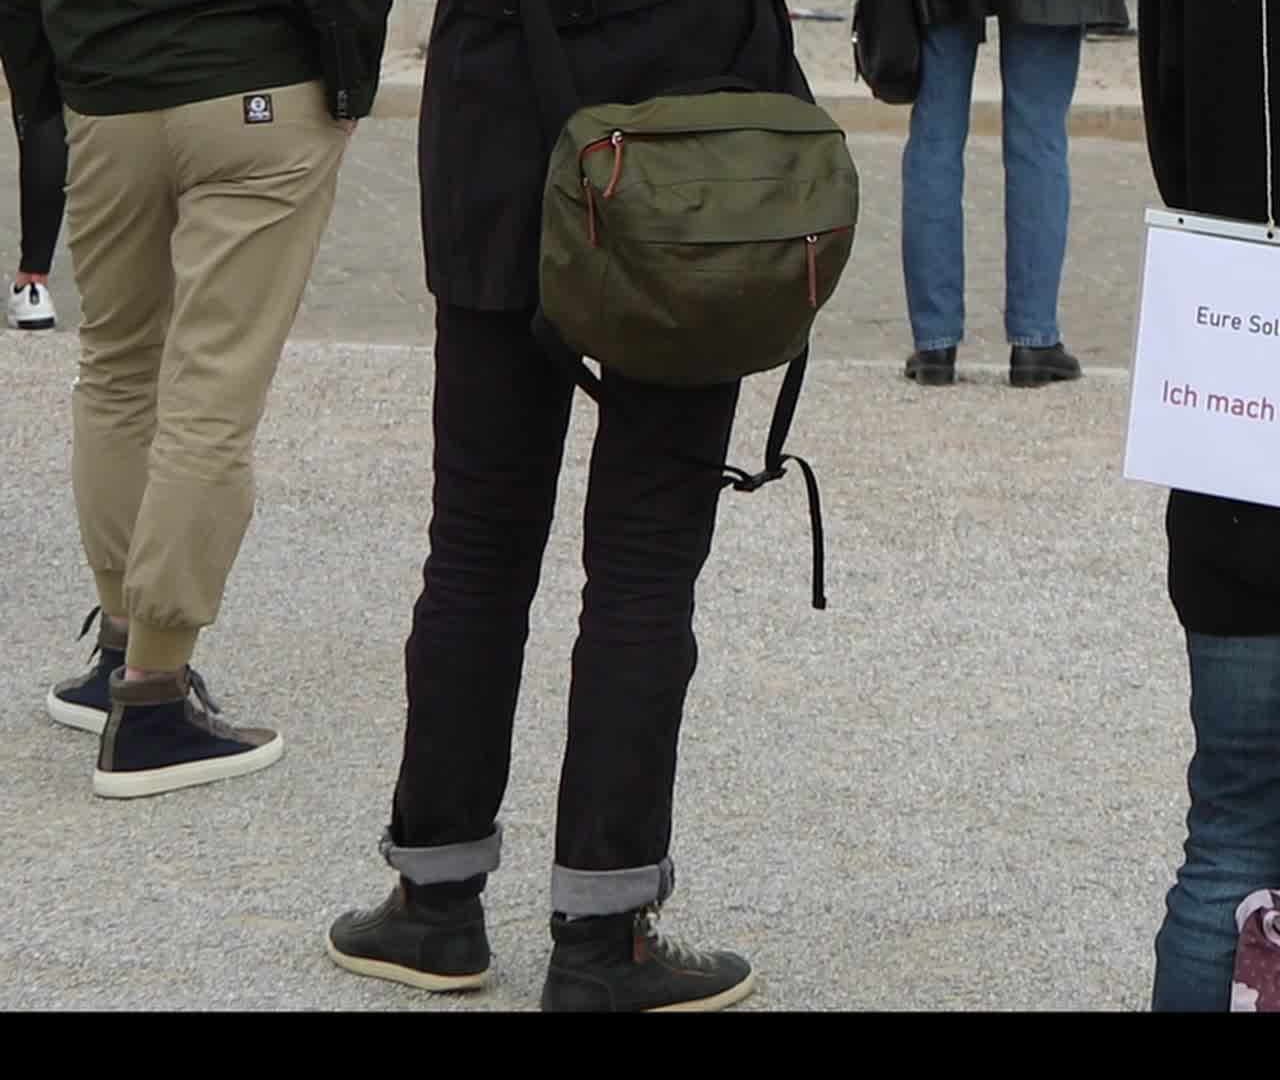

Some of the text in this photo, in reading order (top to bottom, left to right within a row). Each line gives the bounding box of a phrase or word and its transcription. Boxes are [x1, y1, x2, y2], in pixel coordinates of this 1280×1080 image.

[1196, 306, 1242, 331] Eure
[1162, 380, 1198, 409] Ich
[1206, 392, 1275, 422] mach
